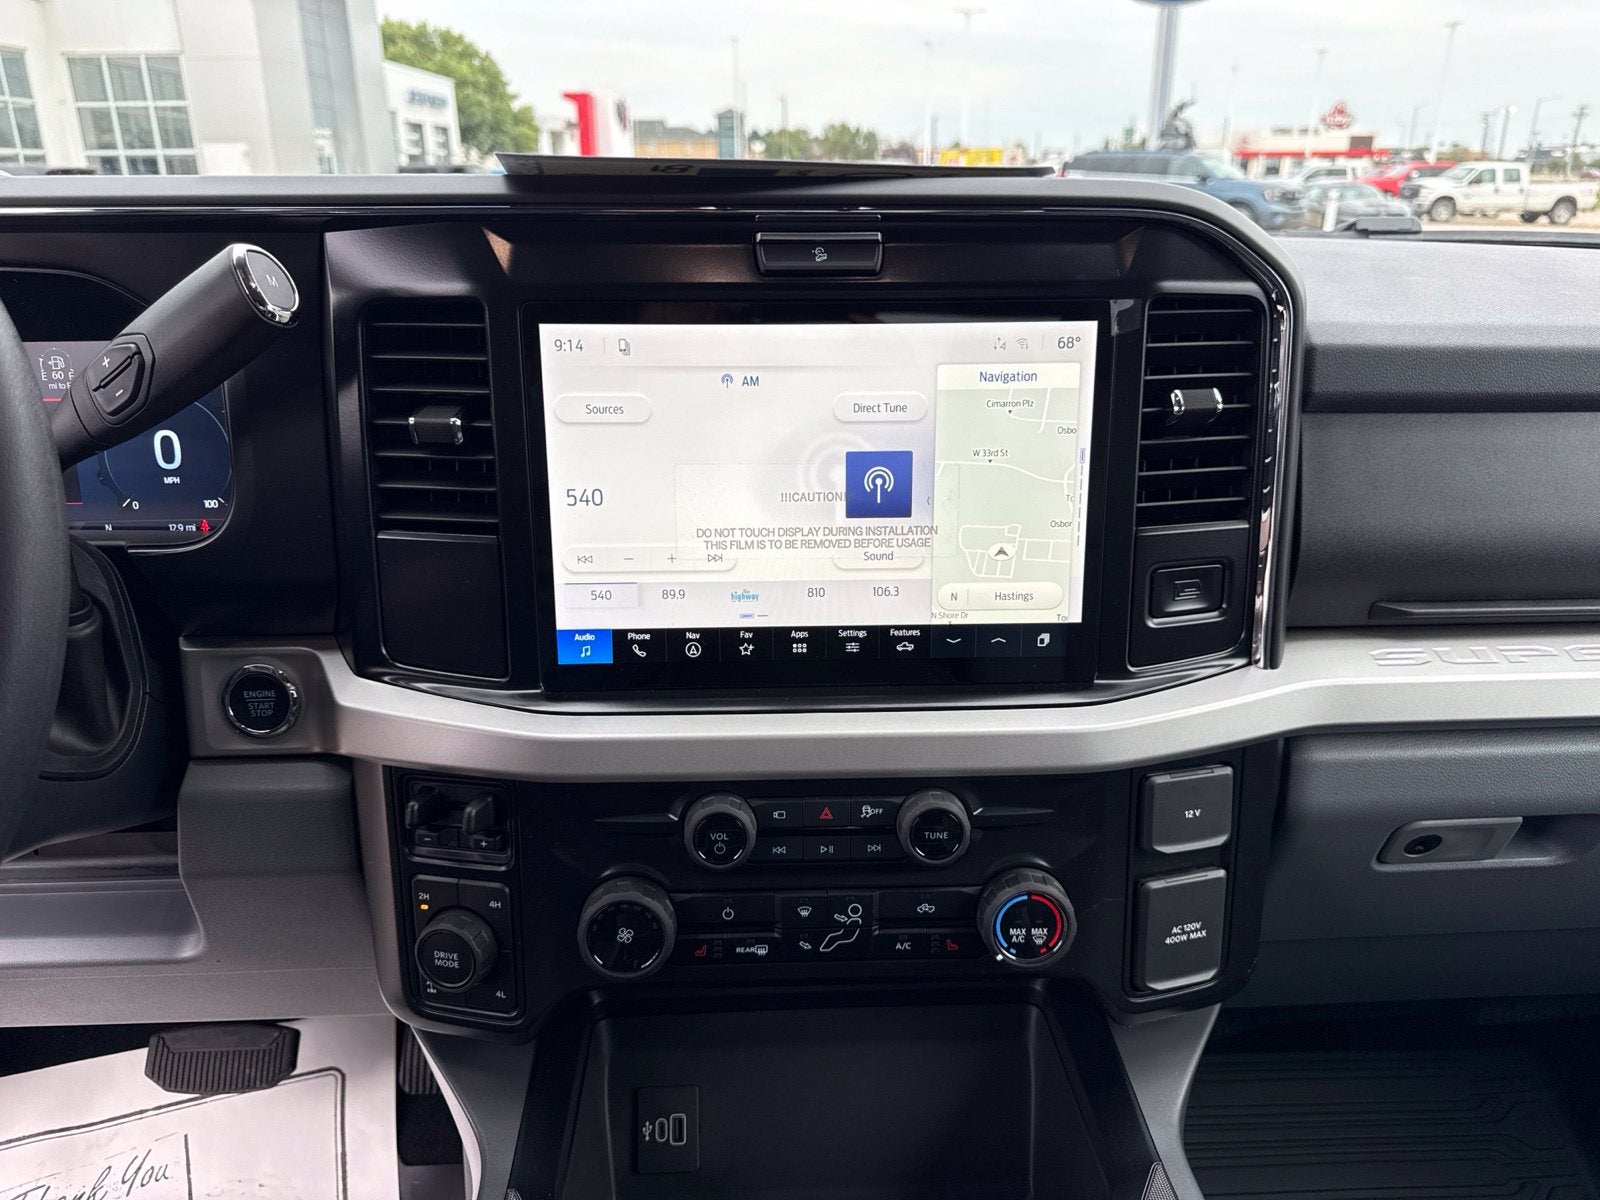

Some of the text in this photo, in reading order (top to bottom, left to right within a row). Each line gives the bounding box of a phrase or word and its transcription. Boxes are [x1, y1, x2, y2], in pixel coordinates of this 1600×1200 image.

[266, 274, 279, 288] M
[554, 338, 584, 352] 9:14
[1057, 336, 1082, 350] 68°
[42, 372, 48, 380] E
[52, 370, 64, 380] 60
[68, 372, 74, 380] F
[978, 370, 1038, 382] Navigation
[742, 375, 760, 387] AM
[852, 402, 908, 413] Direct Tune
[986, 398, 1034, 408] Cimarron Plz
[585, 404, 624, 415] Sources
[1057, 426, 1077, 435] Osbo
[153, 429, 182, 470] 0
[972, 448, 1009, 458] W 33rd St
[164, 476, 180, 485] MPH
[566, 488, 604, 506] 540
[132, 501, 140, 510] 0
[203, 500, 218, 508] 100
[168, 524, 196, 532] 17.9 mi
[696, 525, 938, 538] DO NOT TOUCH DISPLAY DURING INSTALLATION
[704, 538, 932, 550] THIS FILM IS TO BE REMOVED BEFORE USAGE
[864, 551, 894, 562] Sound
[590, 590, 612, 600] 540
[662, 589, 686, 600] 89.9
[807, 587, 826, 598] 810
[872, 586, 900, 597] 106.3
[994, 591, 1034, 602] Hastings
[730, 592, 760, 602] highway
[950, 593, 958, 602] N
[574, 632, 596, 641] Audio
[627, 632, 651, 640] Phone
[686, 632, 700, 640] Nav
[740, 631, 754, 639] Fav
[790, 630, 808, 639] Apps
[838, 629, 868, 638] Settings
[890, 628, 920, 637] Features
[243, 690, 276, 698] ENGINE
[248, 702, 274, 710] START
[870, 808, 884, 816] OFF
[710, 832, 729, 840] VOL
[924, 831, 950, 840] TUNE
[489, 901, 502, 909] 4H
[1010, 928, 1026, 936] MAX
[1032, 928, 1048, 936] MAX
[1172, 922, 1202, 934] AC 120V
[1012, 936, 1026, 944] A/C
[1164, 930, 1207, 944] 400W MAX
[896, 941, 912, 951] A/C
[434, 950, 459, 960] DRIVE
[434, 958, 460, 968] MODE
[496, 990, 506, 998] 4L
[121, 1149, 168, 1197] You
